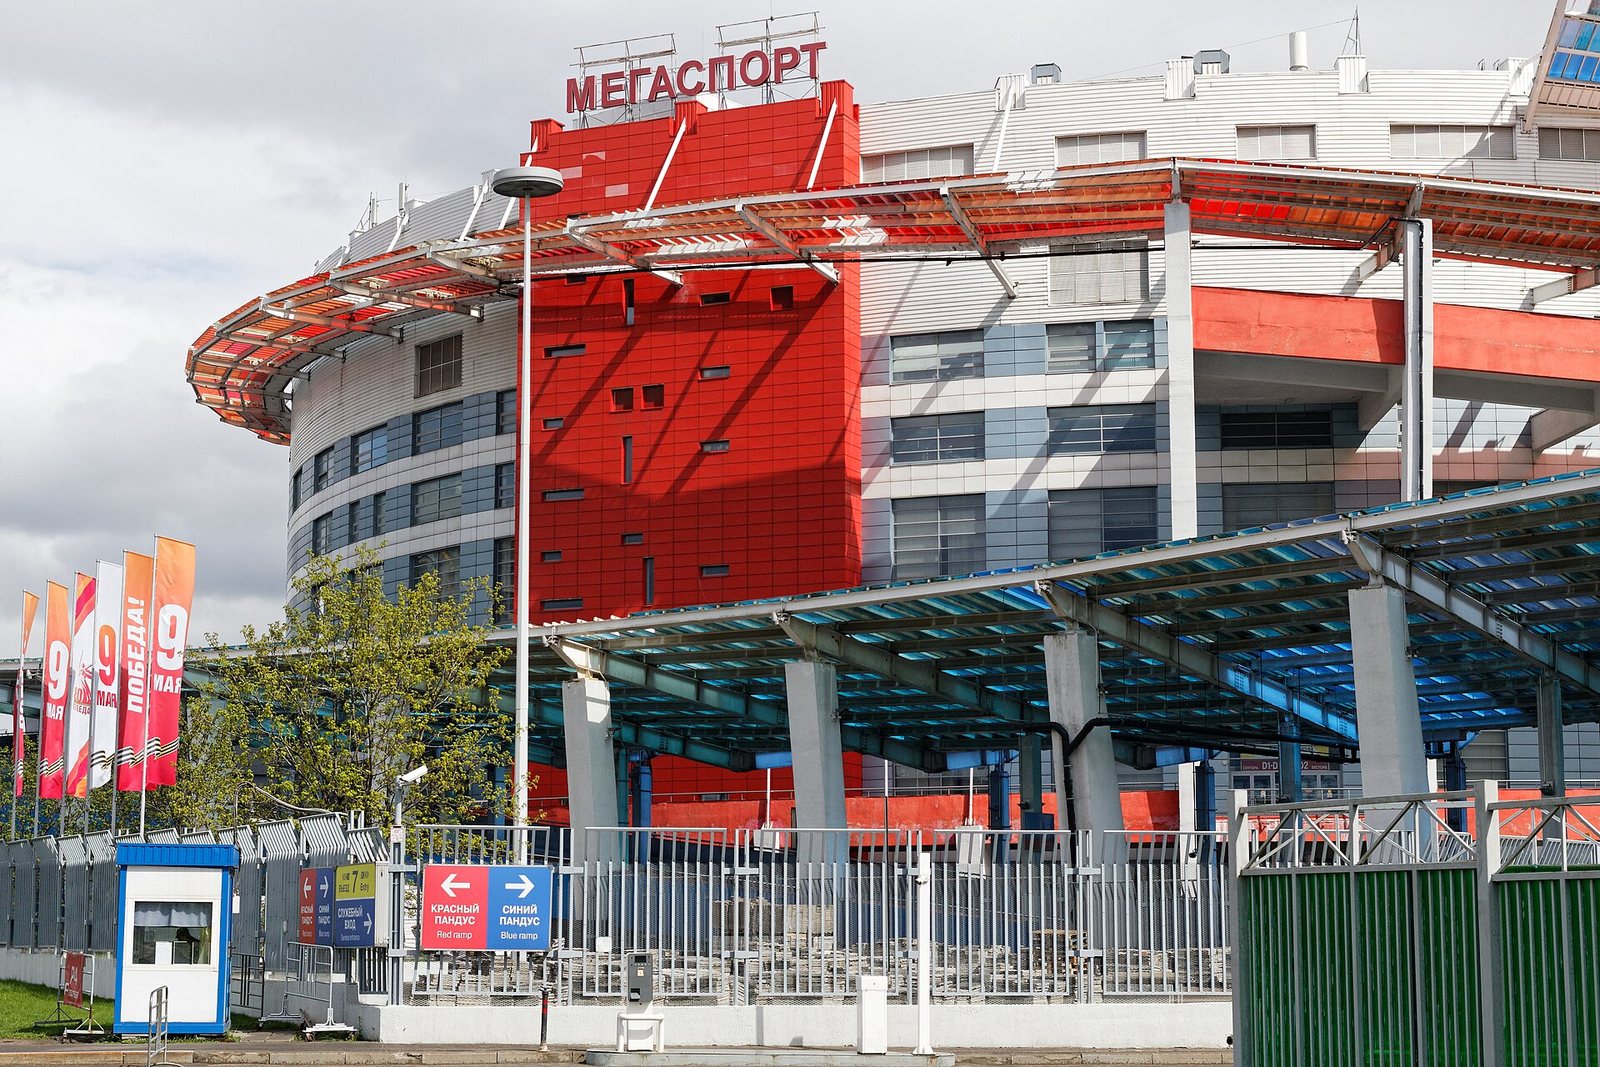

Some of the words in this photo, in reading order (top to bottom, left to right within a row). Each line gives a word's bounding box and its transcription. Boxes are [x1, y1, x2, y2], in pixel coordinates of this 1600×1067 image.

[566, 41, 827, 113] МЕГАСПОРТ
[157, 604, 188, 670] 9
[99, 624, 116, 686] 9
[128, 596, 146, 713] ПОБЕДА!
[48, 640, 69, 700] 9
[154, 673, 182, 694] МАЯ
[96, 690, 117, 708] МАЯ
[46, 702, 64, 720] МАЯ
[352, 870, 358, 893] 7
[431, 903, 480, 914] КРАСНЫЙ
[502, 903, 538, 915] СИНИЙ
[434, 916, 476, 926] ПАНДУС
[499, 916, 541, 926] ПАНДУС
[436, 930, 452, 939] Red
[453, 931, 472, 940] ramp
[500, 931, 517, 940] Blue
[518, 932, 538, 941] ramp
